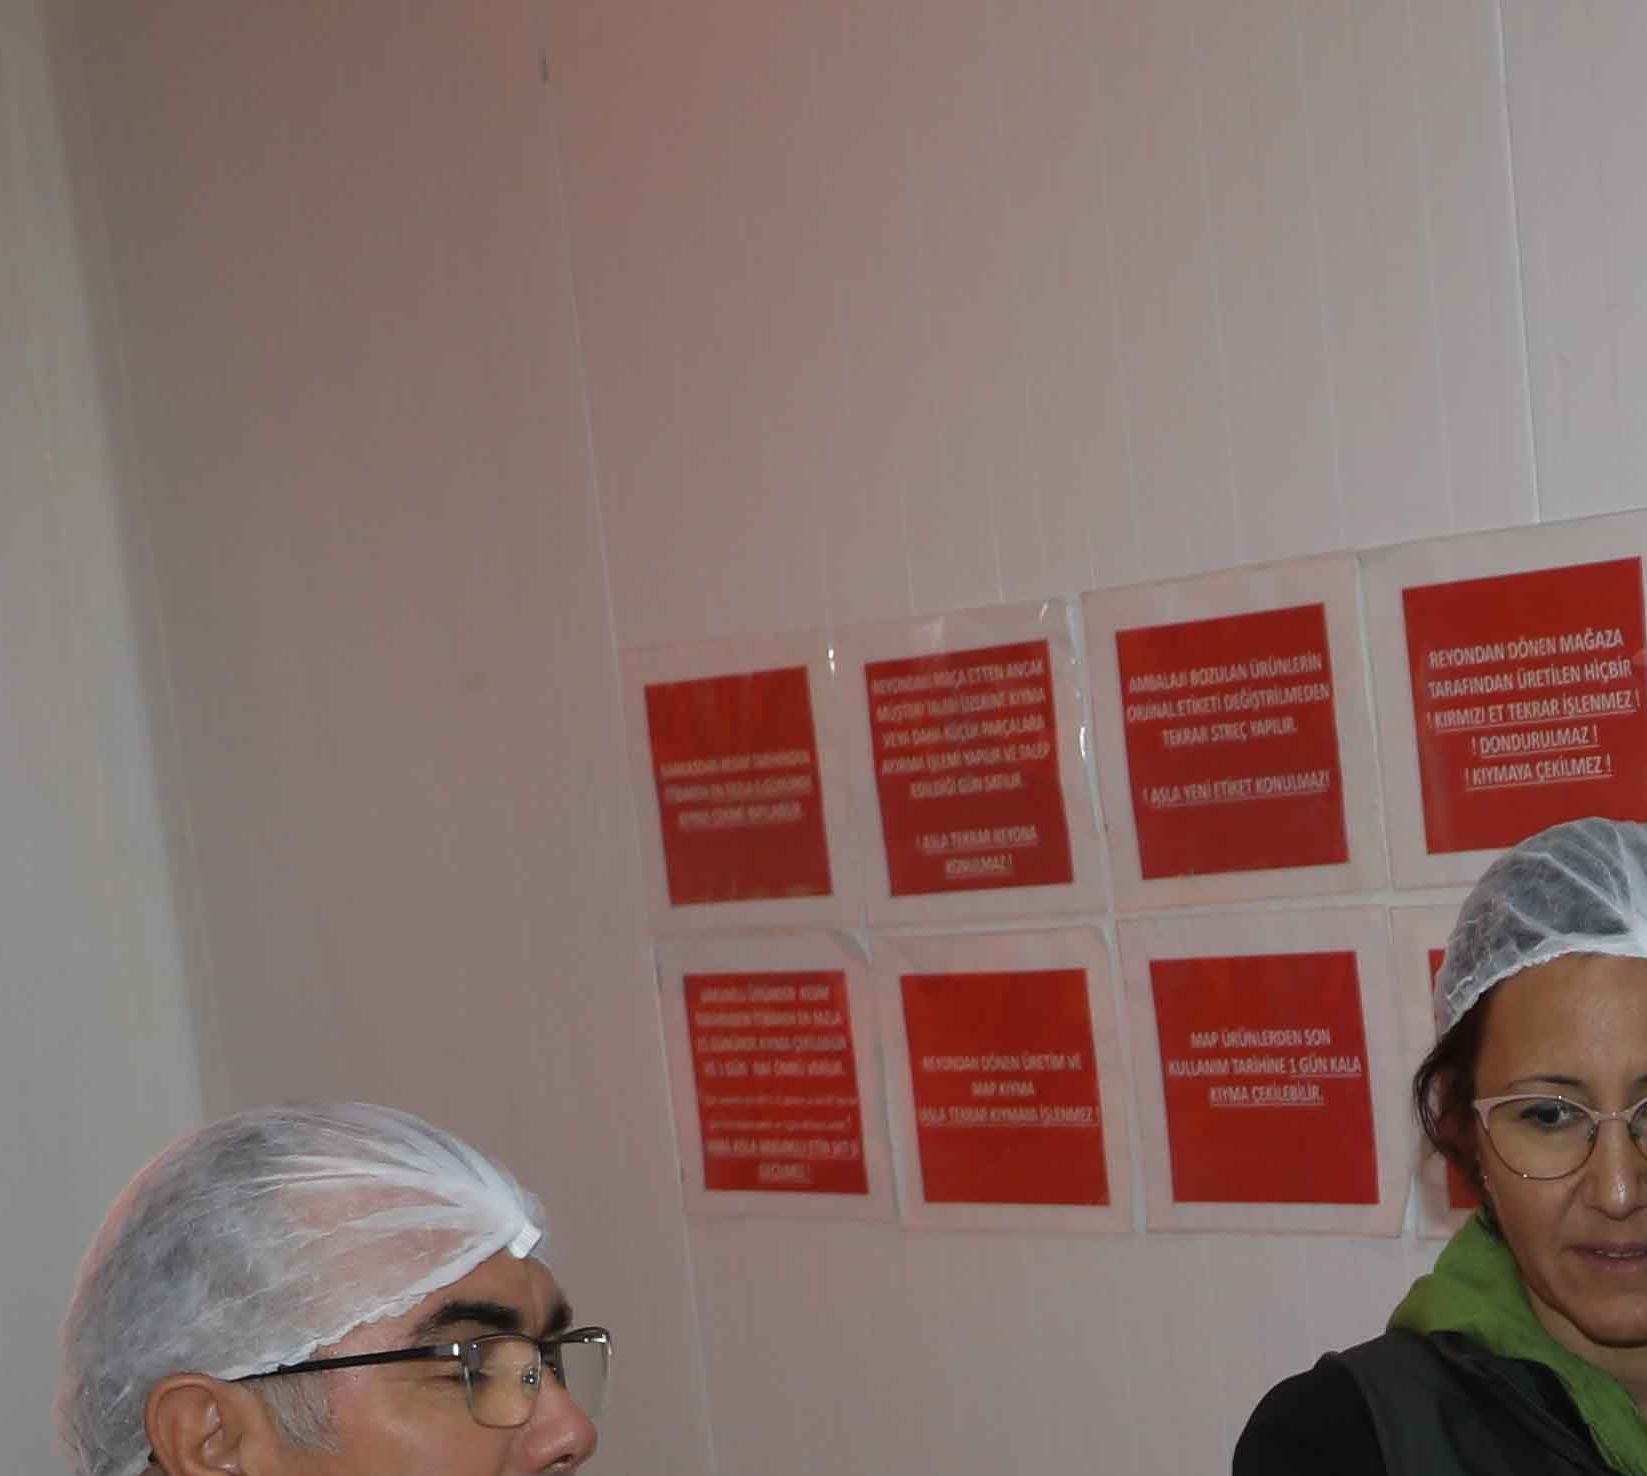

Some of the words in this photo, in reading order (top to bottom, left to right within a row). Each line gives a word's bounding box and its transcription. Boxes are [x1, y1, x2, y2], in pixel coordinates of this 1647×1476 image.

[1429, 644, 1506, 669] REYONDAN
[1507, 636, 1556, 659] DÖNEN
[1559, 627, 1624, 652] MAĞAZA
[1190, 662, 1248, 687] BOZULAN
[1249, 650, 1323, 680] ÜRÜNLERİN
[1428, 673, 1514, 699] TARAFINDAN
[1517, 663, 1582, 690] ÜRETİLEN
[1584, 656, 1633, 684] HİÇBİR
[1434, 706, 1486, 729] KIRMIZI
[1489, 704, 1504, 723] ET
[1508, 701, 1562, 722] TEKRAR
[1563, 689, 1633, 715] İŞLENMEZ
[1162, 727, 1209, 748] TEKRAR
[1210, 720, 1247, 744] STREÇ
[1480, 725, 1589, 755] DONDURULMAZ
[1473, 763, 1533, 786] KIYMAYA
[1536, 754, 1602, 783] ÇEKİLMEZ
[1221, 1026, 1304, 1048] ÜRÜNLERDEN
[1305, 1028, 1331, 1046] SON
[1168, 1058, 1230, 1077] KULLANIM
[1232, 1054, 1287, 1075] TARİHİNE
[1298, 1054, 1327, 1073] GÜN
[1330, 1055, 1362, 1073] KALA
[1210, 1085, 1249, 1104] KIYMA
